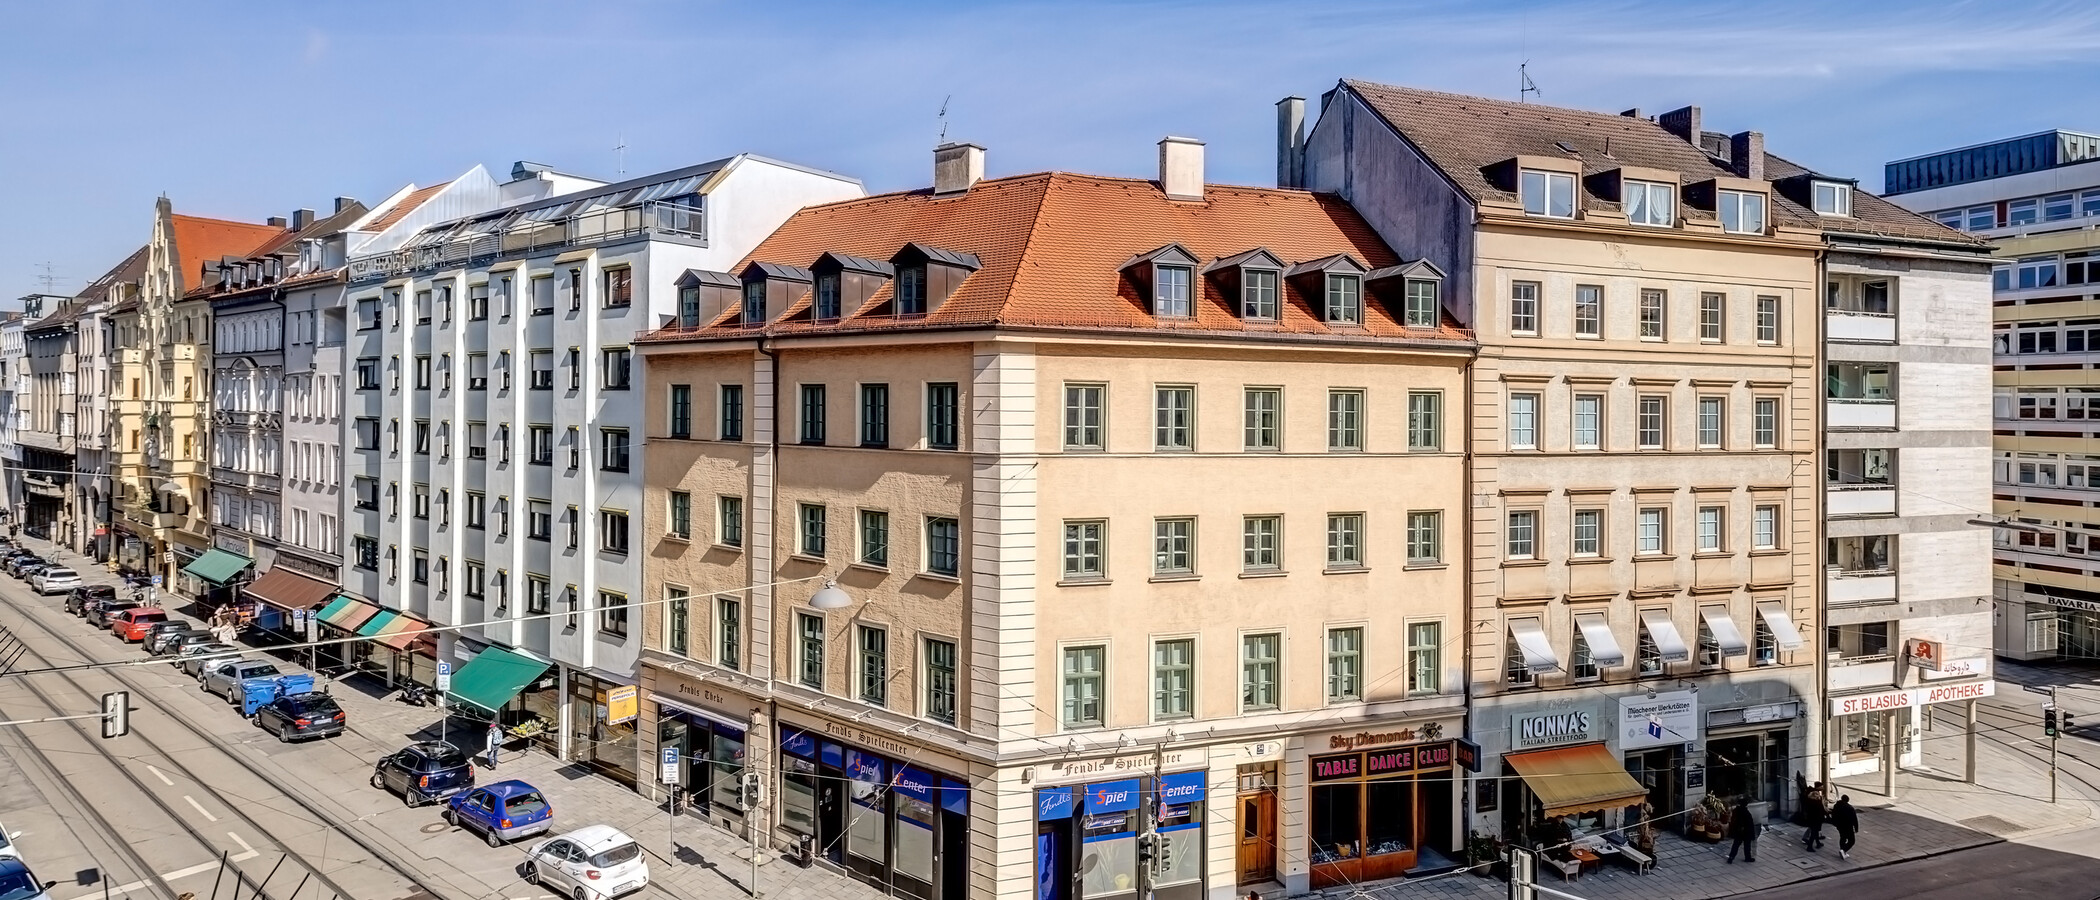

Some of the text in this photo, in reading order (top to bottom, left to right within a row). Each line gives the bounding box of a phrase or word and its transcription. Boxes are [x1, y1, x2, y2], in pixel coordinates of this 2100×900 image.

[440, 664, 447, 673] P
[679, 683, 723, 704] Fendls Theke
[1843, 683, 1984, 713] ST. BLASIUS APOTHEKE
[1627, 702, 1690, 715] Münchener Werkstätten
[1522, 711, 1590, 739] NONNA'S
[824, 722, 908, 755] Fendls Spielcenter
[1329, 728, 1415, 750] Sky Diamonds
[1521, 734, 1588, 746] ITALIAN STREETFOOD
[1316, 748, 1449, 776] TABLE DANCE CLUB
[1458, 747, 1473, 763] BAR
[854, 758, 926, 794] Spiel Center
[1062, 762, 1105, 777] Fendls
[1040, 783, 1198, 816] Fendls Spiel Center
